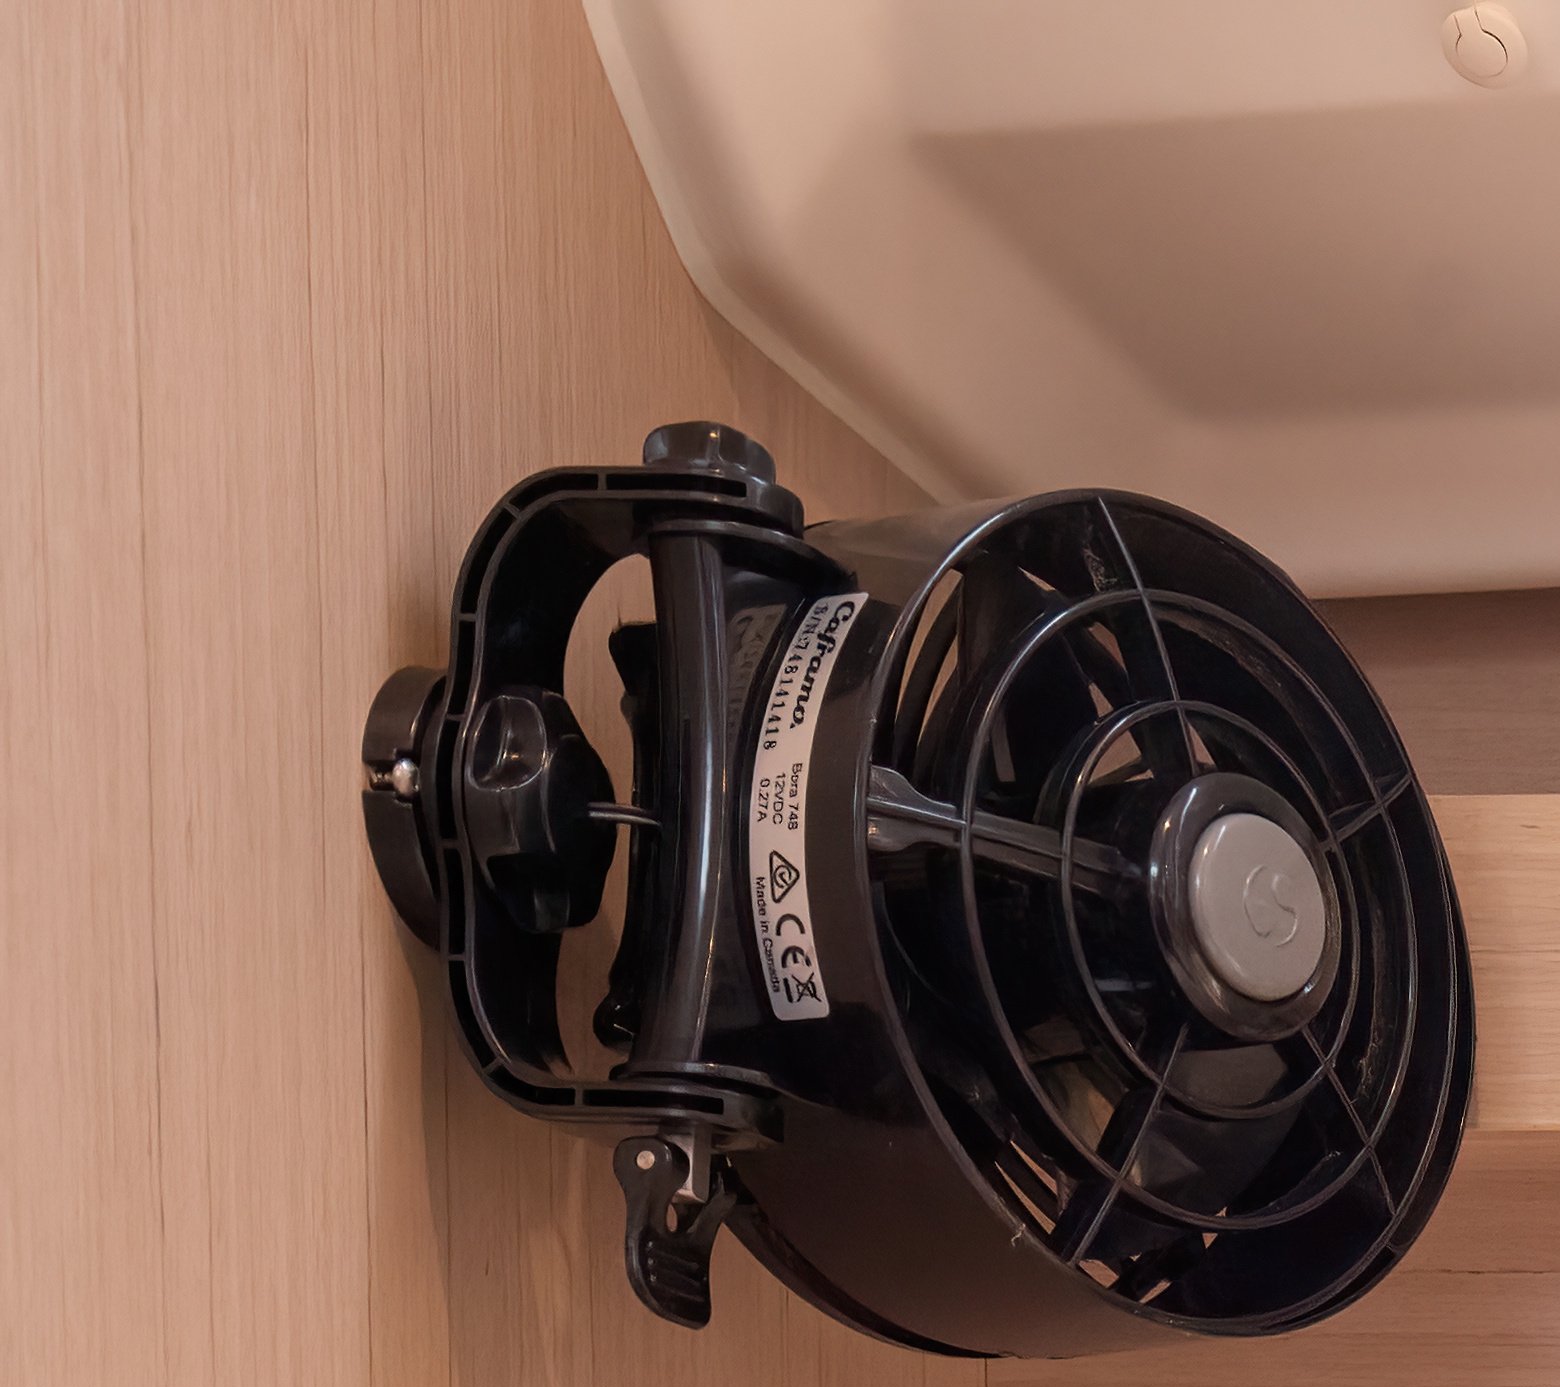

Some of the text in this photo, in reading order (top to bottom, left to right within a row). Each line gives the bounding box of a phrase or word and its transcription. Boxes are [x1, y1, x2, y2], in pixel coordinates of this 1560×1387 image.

[757, 778, 770, 822] 0.27A
[773, 772, 786, 825] 12VDC
[788, 763, 803, 830] Bora 748
[760, 920, 770, 933] in
